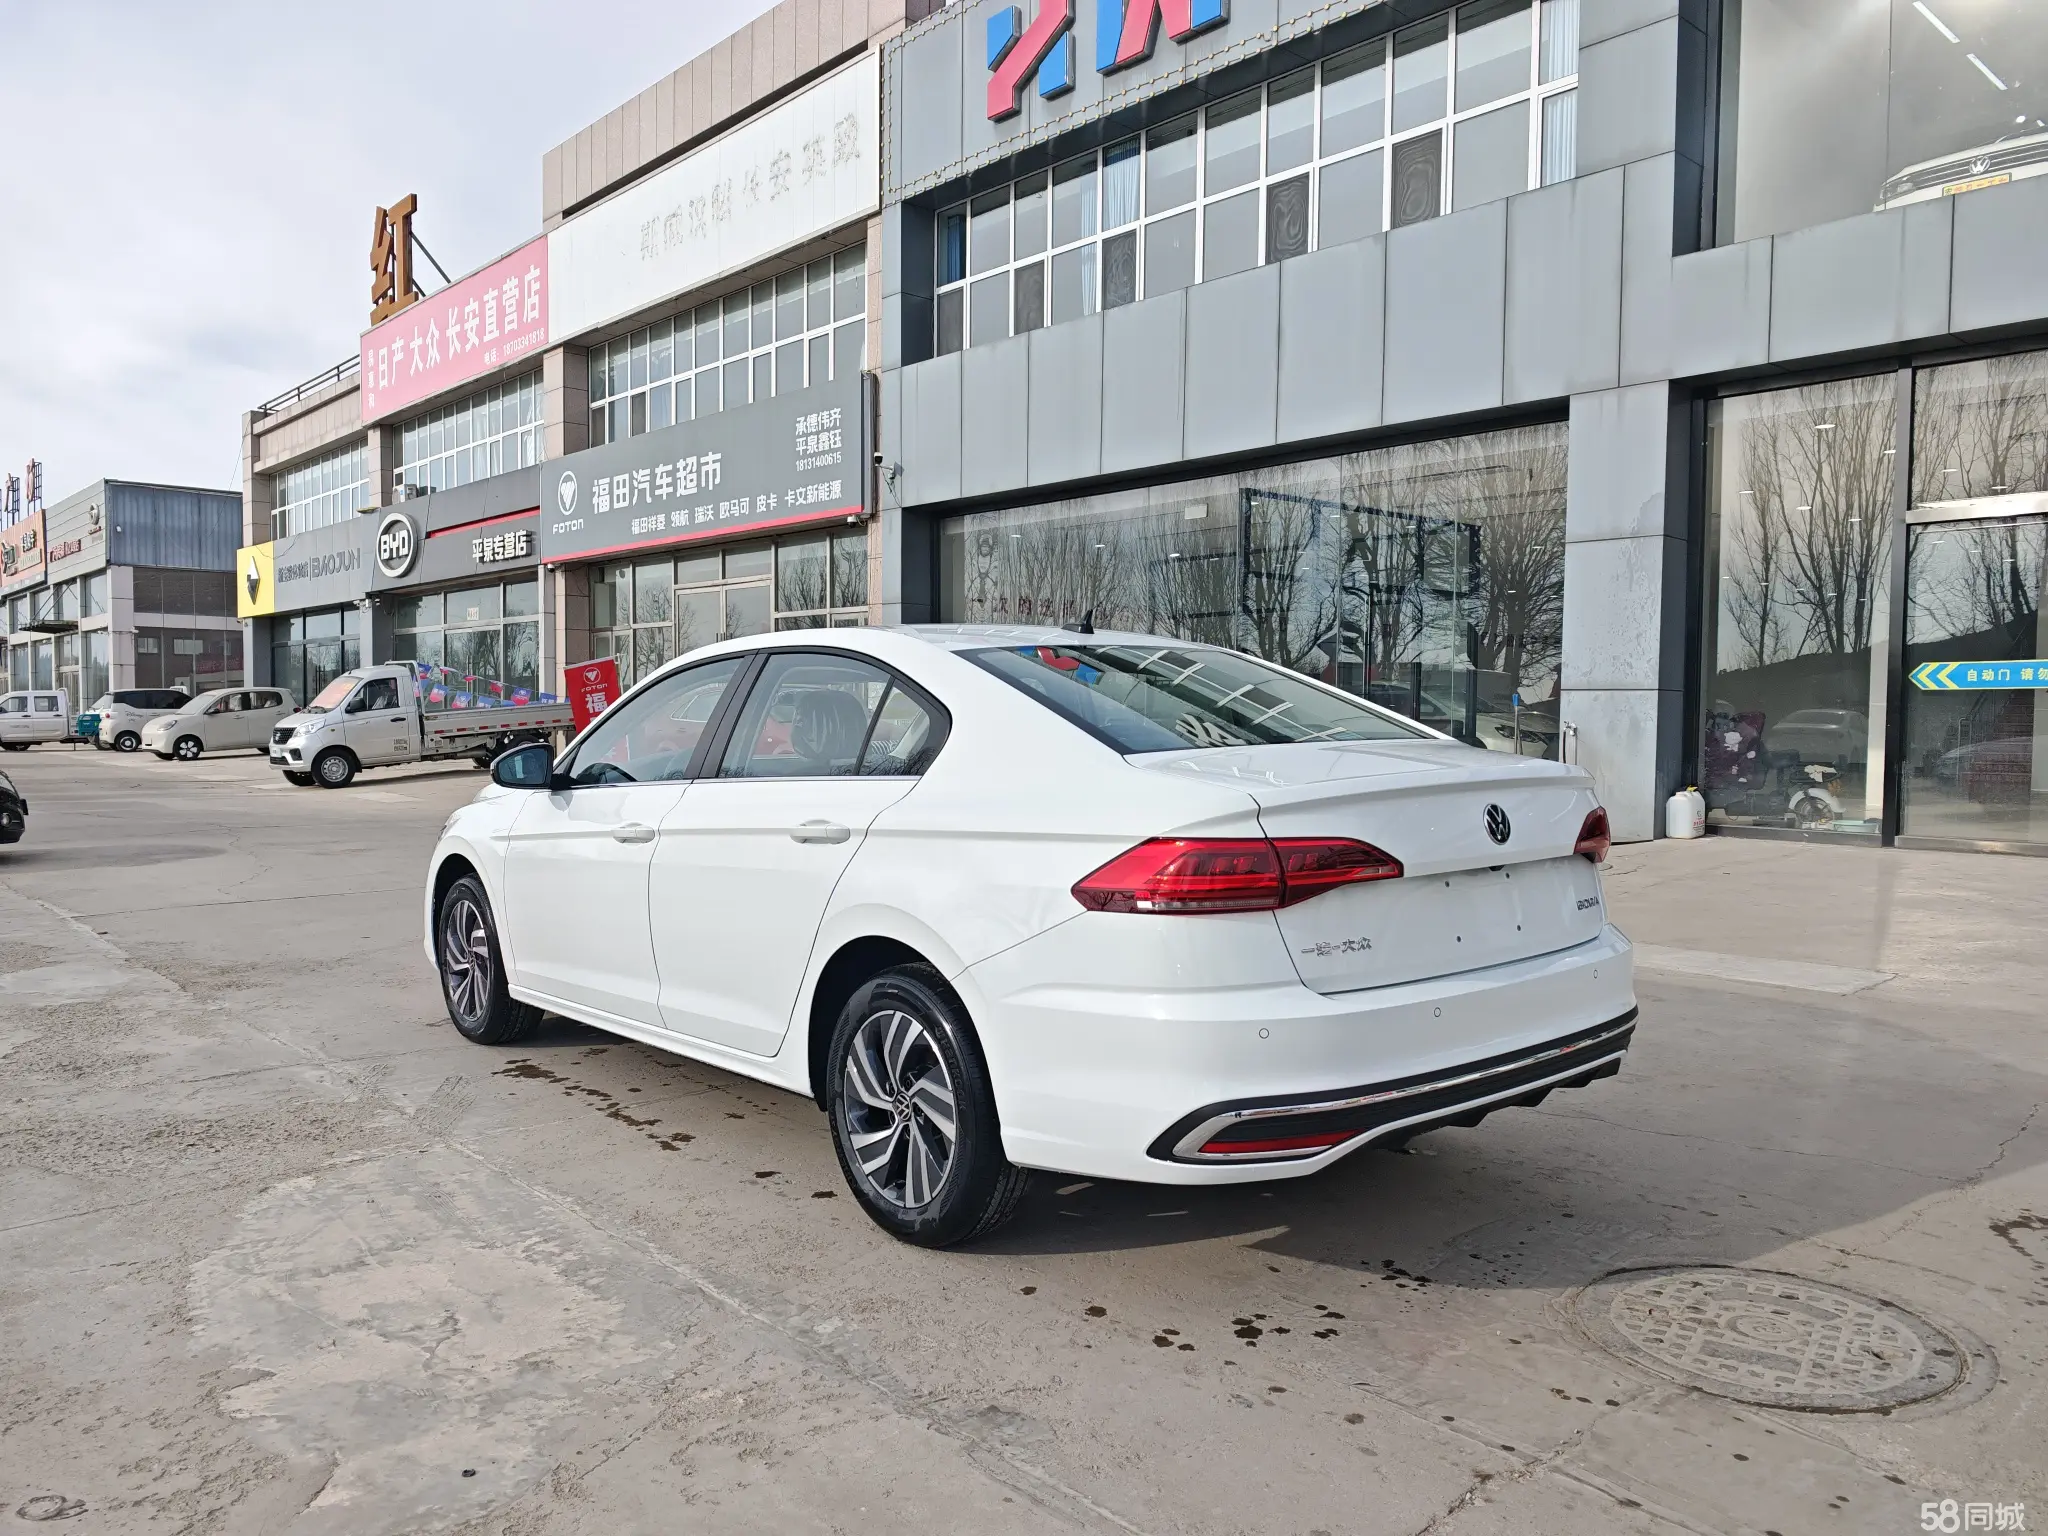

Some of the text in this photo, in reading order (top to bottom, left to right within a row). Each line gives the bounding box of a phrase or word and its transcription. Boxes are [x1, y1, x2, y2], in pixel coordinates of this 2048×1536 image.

[378, 264, 541, 391] 日产 大众 长安直营店
[795, 407, 842, 436] 承德伟齐
[795, 428, 842, 456] 平泉鑫钰
[795, 451, 842, 472] 18131400615
[592, 452, 723, 514] 福田汽车超市
[631, 479, 842, 535] 福田祥菱 领航 瑞沃 欧马可 皮卡 卡文新能源
[552, 518, 584, 535] FOTON
[381, 529, 409, 560] BYD
[472, 529, 528, 563] 平泉专营店
[311, 547, 361, 578] BAOJUN
[581, 683, 608, 693] FOTON
[1967, 667, 2048, 682] 自动门 请勿
